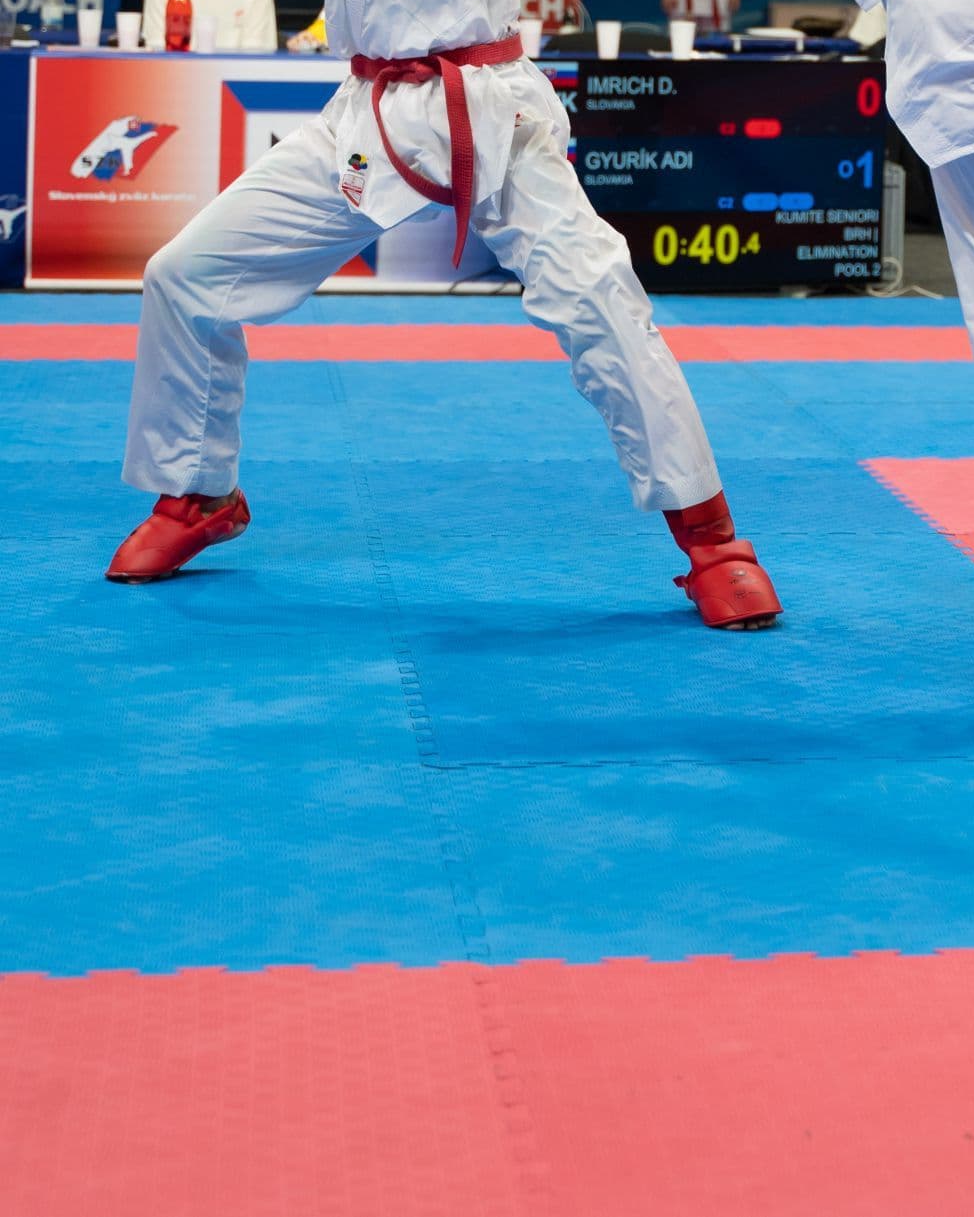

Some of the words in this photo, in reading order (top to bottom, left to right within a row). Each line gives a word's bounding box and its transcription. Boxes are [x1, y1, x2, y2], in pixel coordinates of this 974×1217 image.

[587, 76, 654, 96] IMRICH
[658, 77, 678, 96] D.
[857, 77, 882, 117] 0
[586, 99, 636, 111] SLOVAKIA
[585, 148, 658, 170] GYURÍK
[661, 150, 693, 170] ADI
[584, 174, 634, 186] SLOVAKIA
[775, 209, 825, 224] KUMITE
[796, 245, 878, 260] ELIMINATION
[834, 263, 869, 277] POOL
[871, 263, 881, 276] 2
